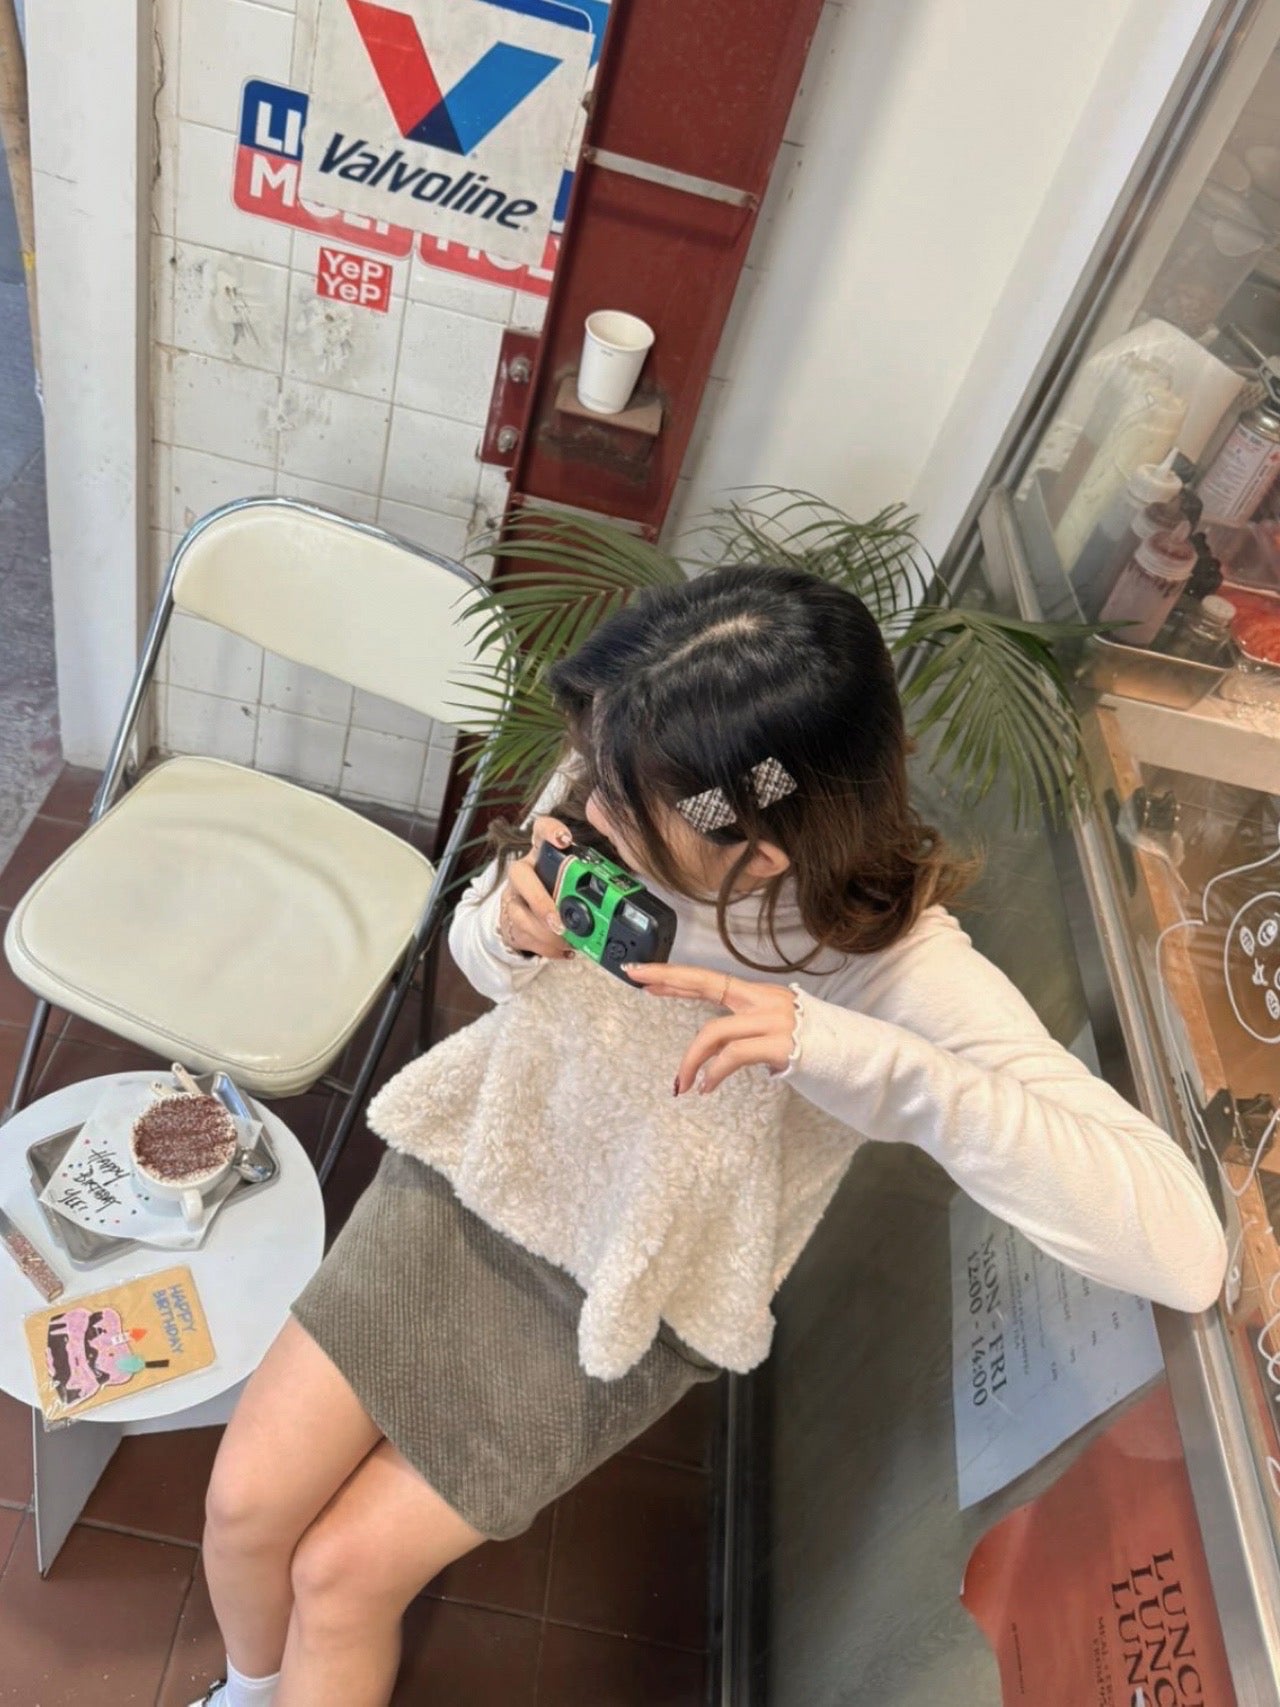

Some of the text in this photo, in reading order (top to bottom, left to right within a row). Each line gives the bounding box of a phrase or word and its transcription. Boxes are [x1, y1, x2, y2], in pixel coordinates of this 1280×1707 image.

[254, 100, 303, 157] LI
[318, 131, 539, 230] Valvoline
[168, 1284, 198, 1333] HAPPY
[967, 1250, 985, 1316] 12:00
[981, 1233, 1002, 1315] MON
[971, 1335, 989, 1407] 14:00
[988, 1333, 1008, 1393] FRI
[1153, 1550, 1204, 1707] LUNC
